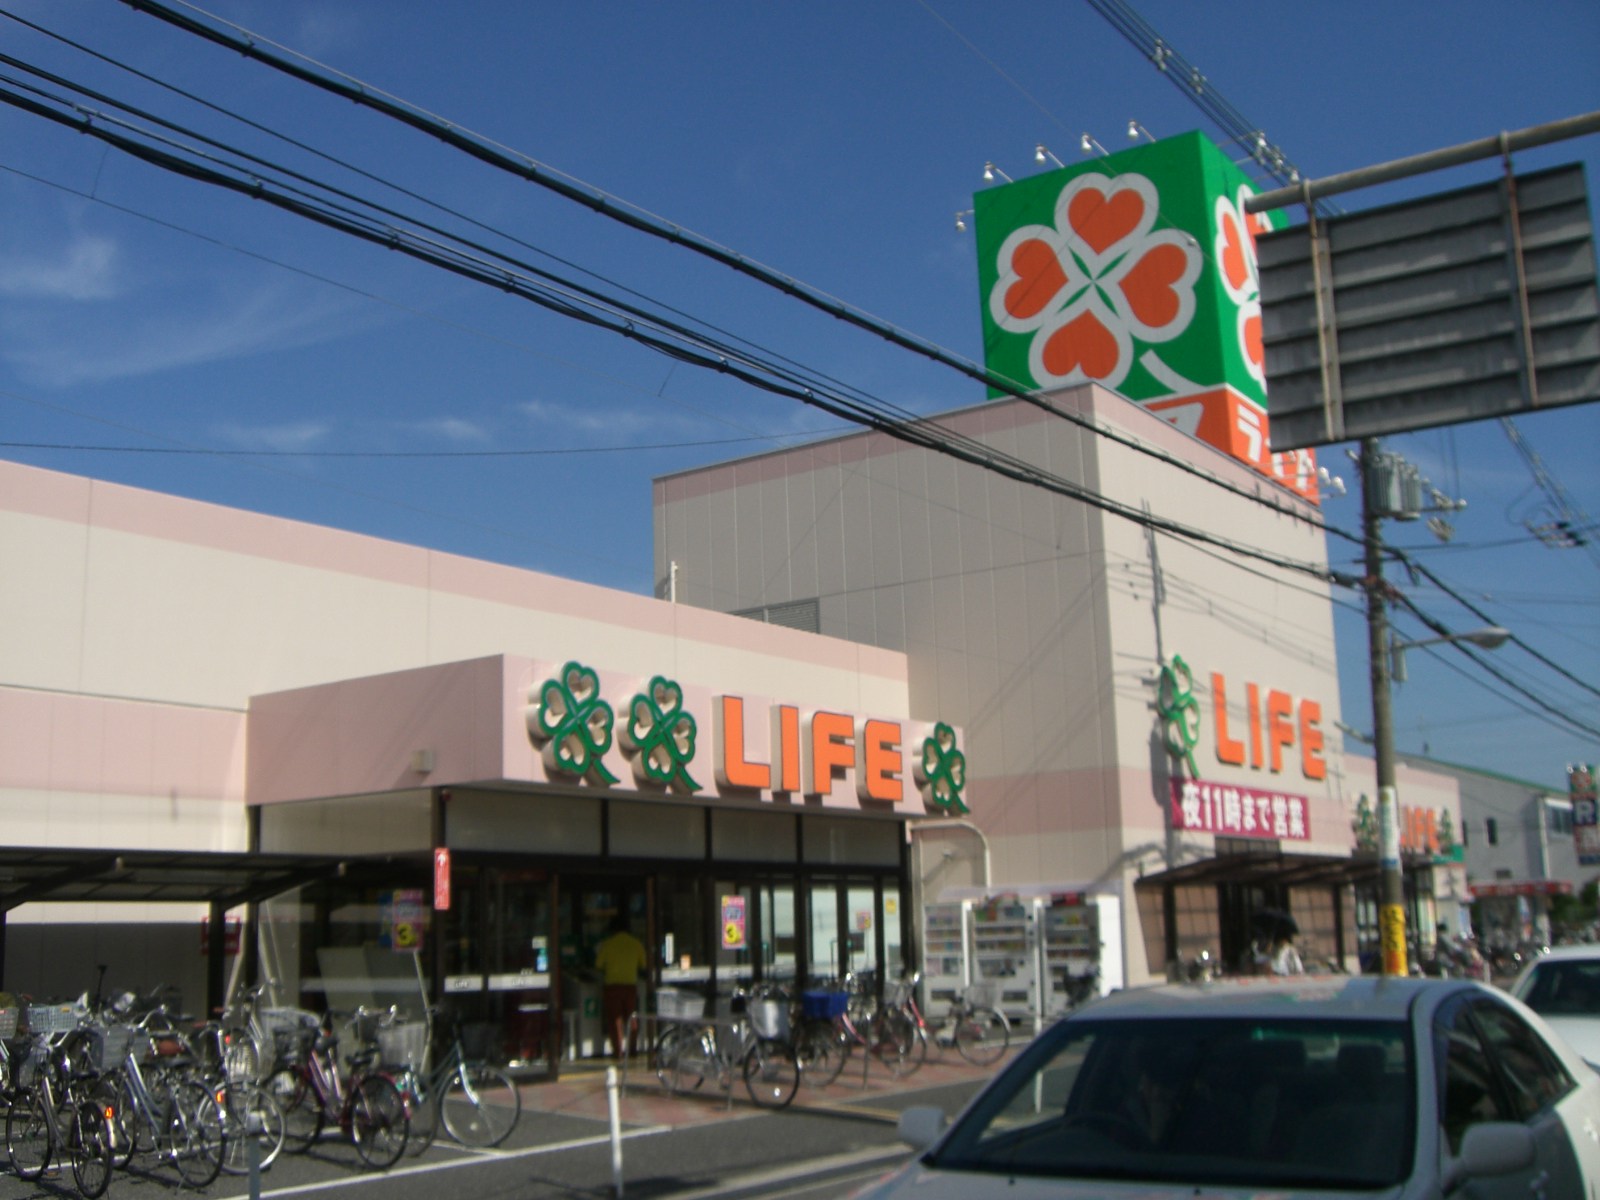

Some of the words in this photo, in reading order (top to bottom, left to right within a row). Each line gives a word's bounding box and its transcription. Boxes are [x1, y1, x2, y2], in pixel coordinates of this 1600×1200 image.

[718, 694, 904, 802] LIFE
[1211, 671, 1326, 780] LIFE
[1182, 782, 1305, 838] 夜11時まで営業
